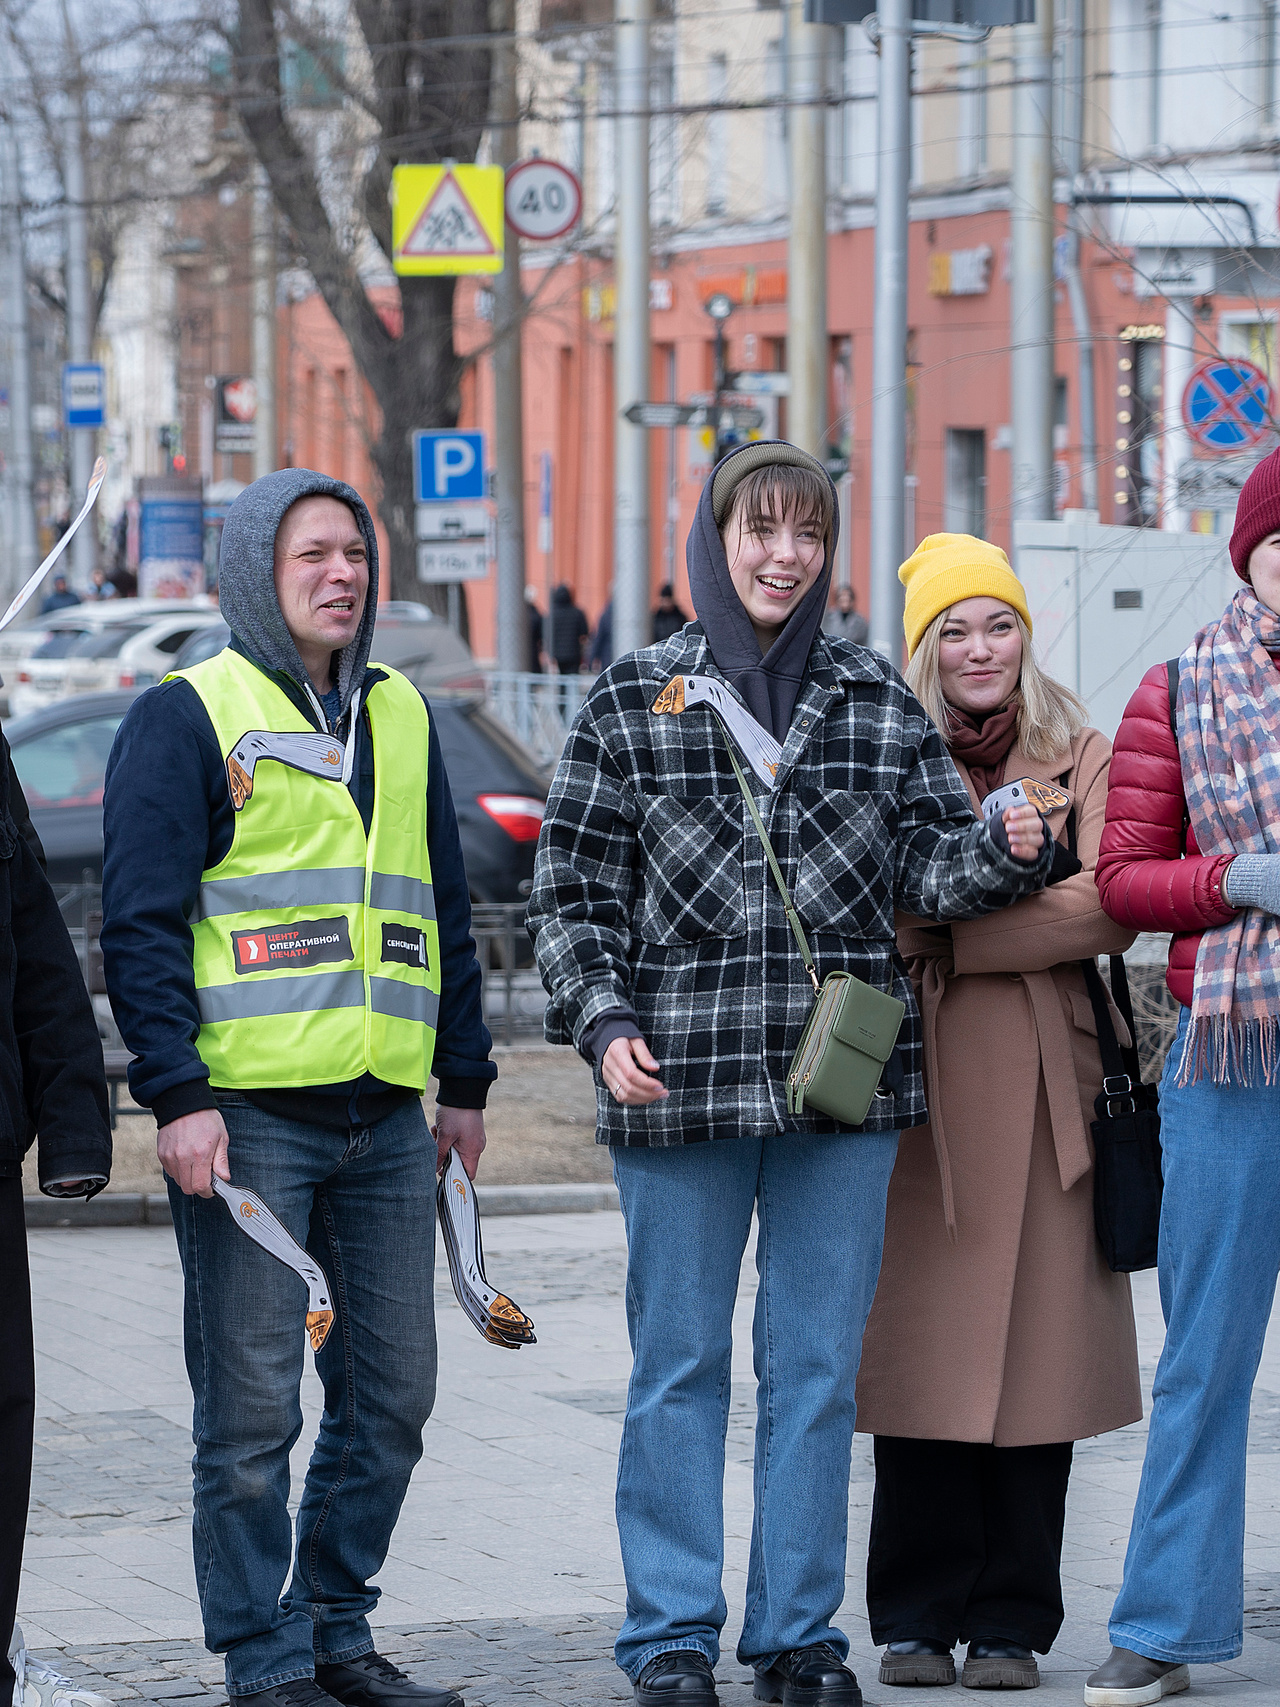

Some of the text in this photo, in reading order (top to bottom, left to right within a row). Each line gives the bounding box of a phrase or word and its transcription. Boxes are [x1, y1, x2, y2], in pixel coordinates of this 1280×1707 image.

[517, 182, 566, 214] 40
[433, 438, 476, 496] P
[267, 931, 300, 943] ЦЕНТР
[269, 933, 340, 951] ОПЕРАТИВНОЙ
[270, 947, 309, 960] ПЕЧАТИ
